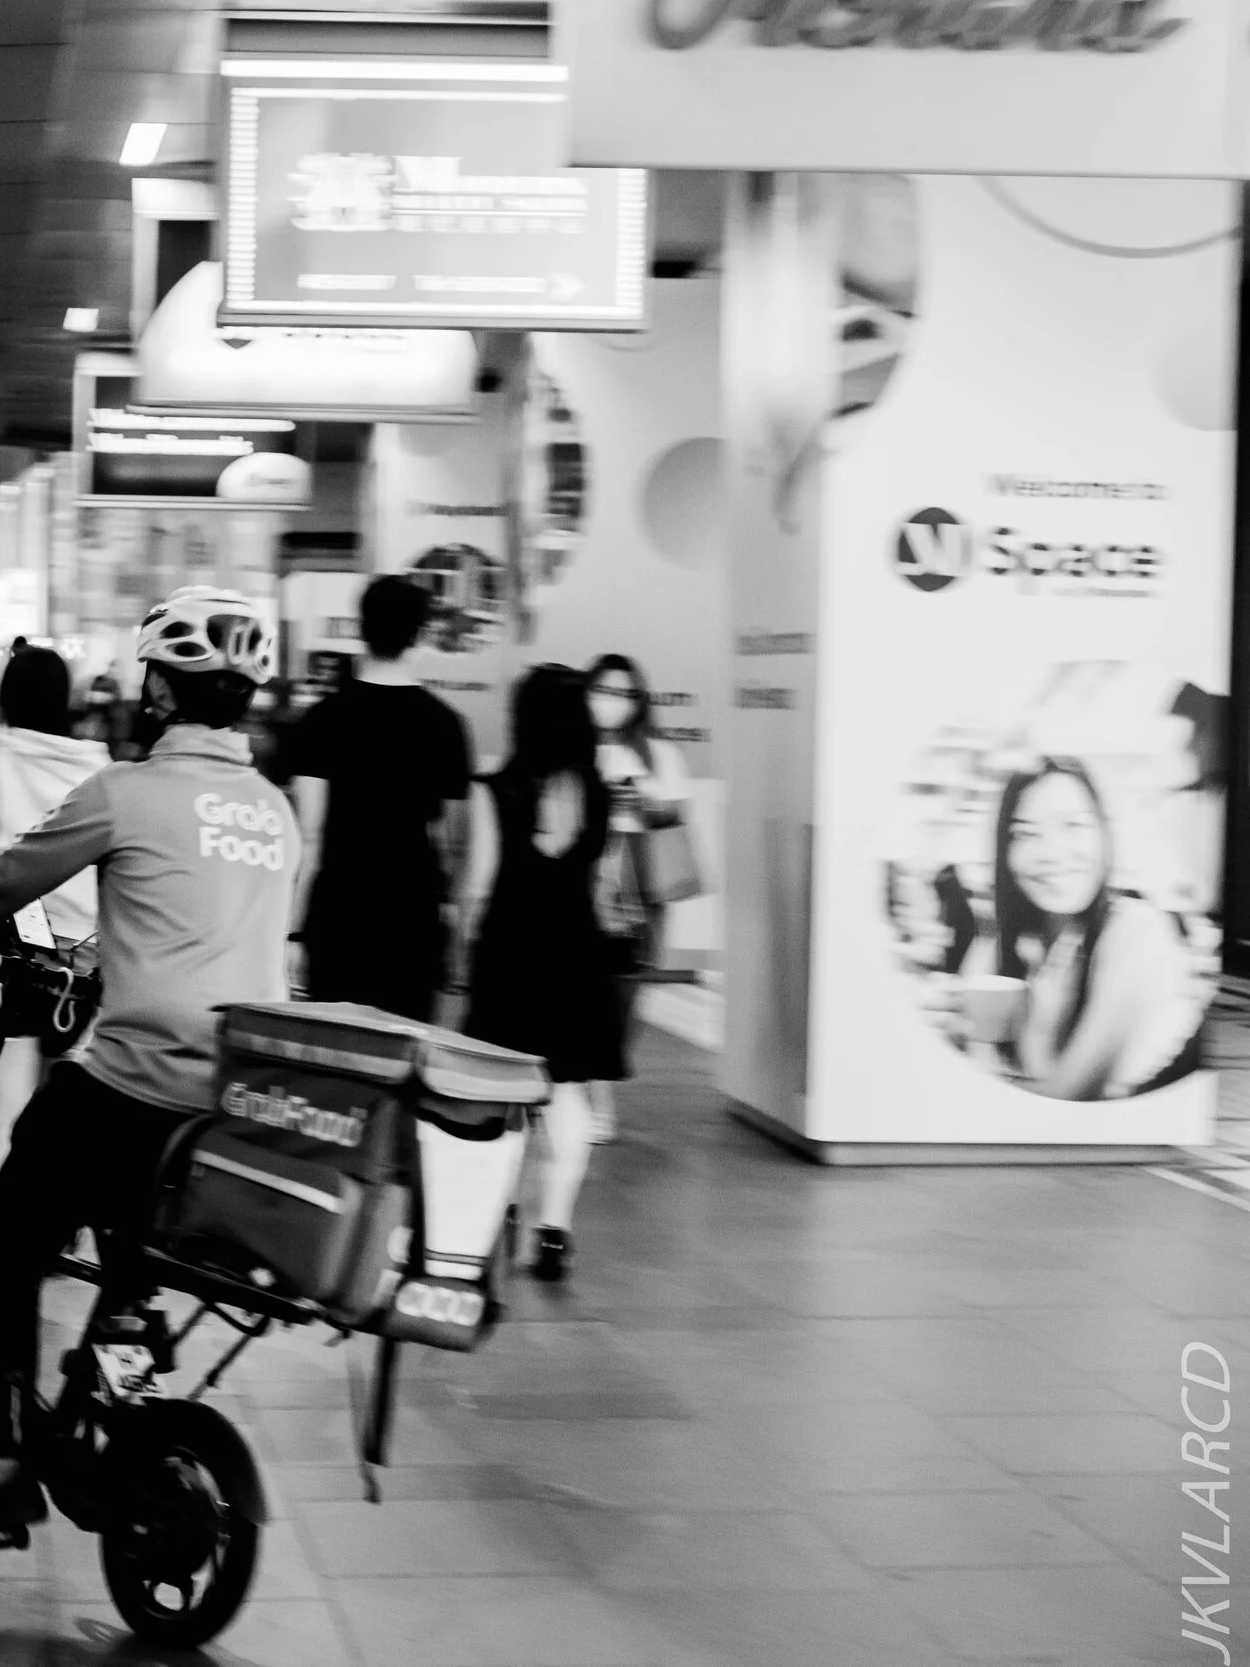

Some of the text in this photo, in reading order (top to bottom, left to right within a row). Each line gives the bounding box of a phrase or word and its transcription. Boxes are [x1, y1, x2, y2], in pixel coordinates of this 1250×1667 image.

[986, 525, 1163, 588] Space
[194, 792, 284, 836] Grab
[198, 826, 285, 871] Food
[221, 1081, 368, 1148] GrabFood
